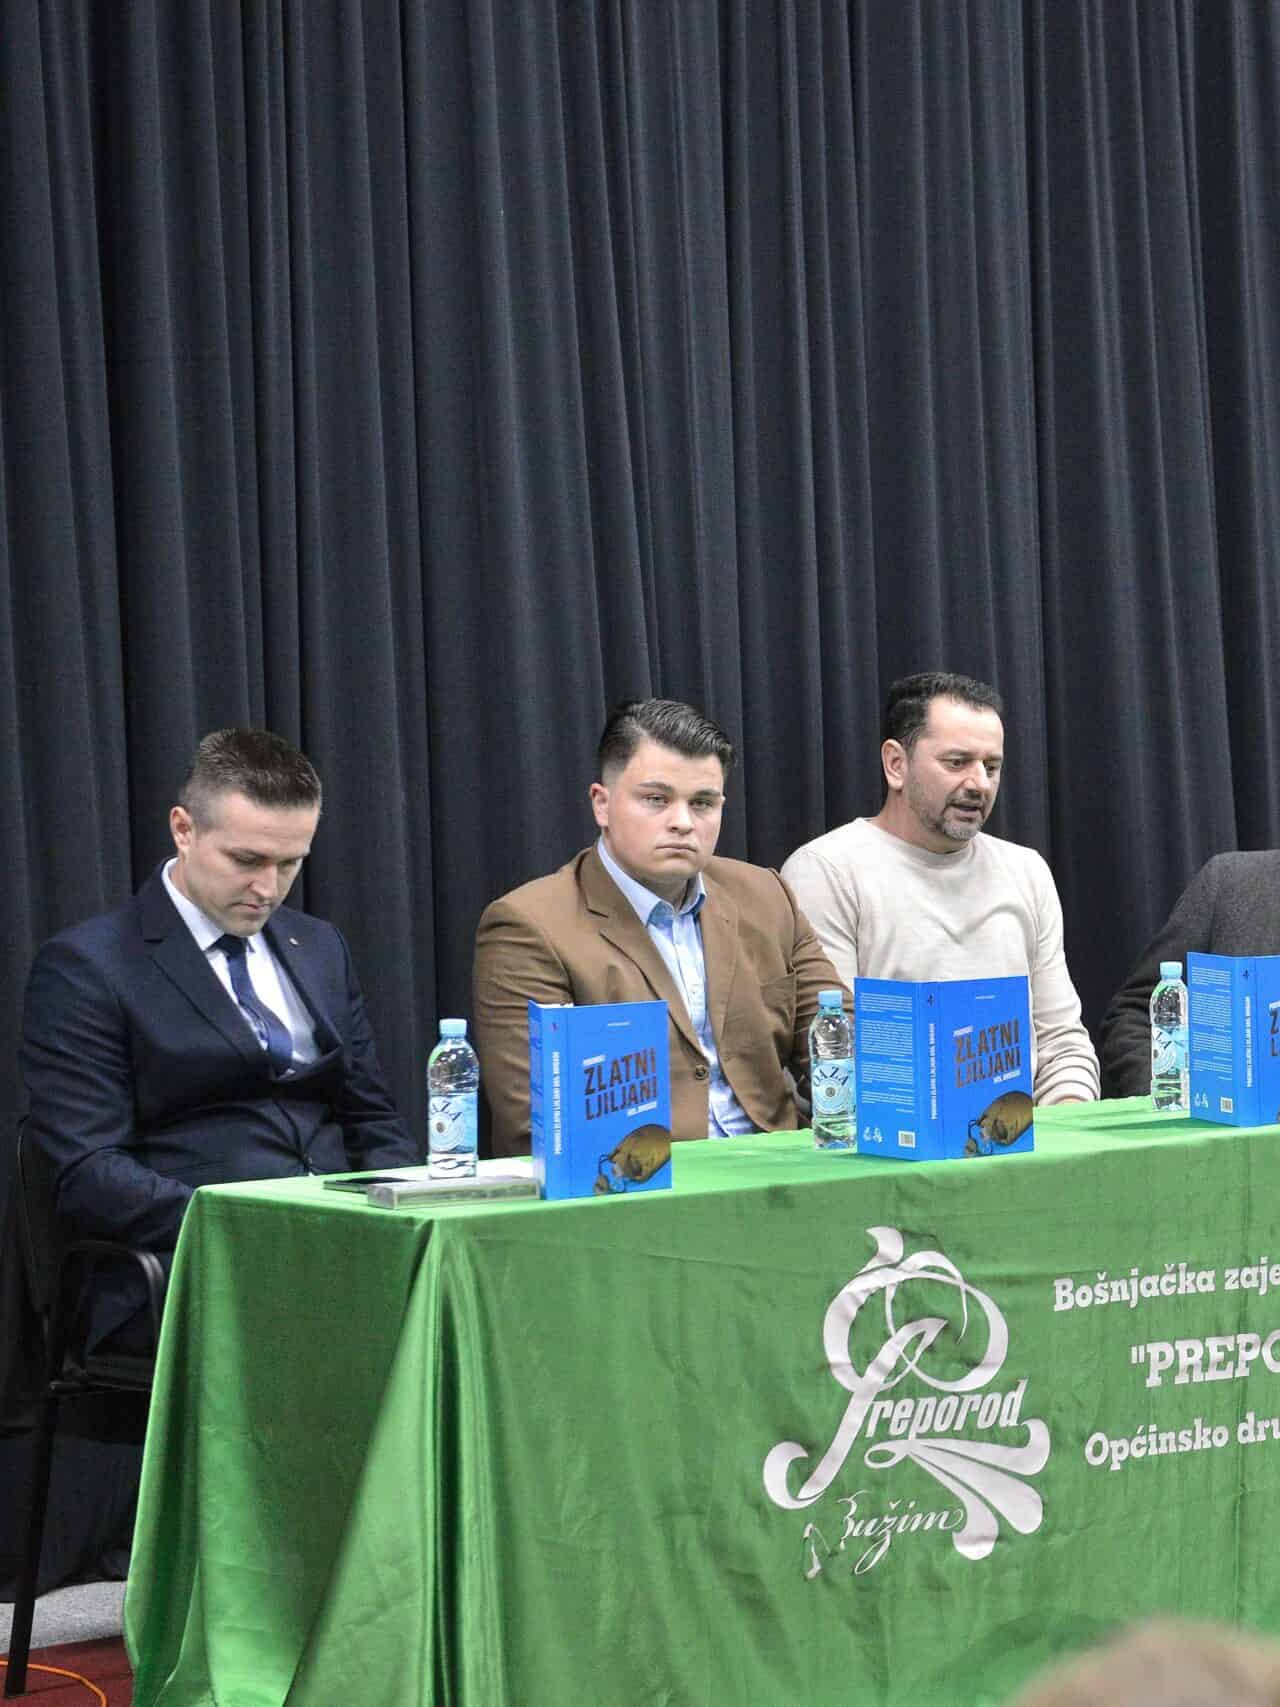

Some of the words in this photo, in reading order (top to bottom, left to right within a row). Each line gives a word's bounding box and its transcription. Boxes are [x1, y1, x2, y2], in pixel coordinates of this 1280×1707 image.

[955, 1018, 1020, 1064] ZLATNI
[583, 1047, 657, 1096] ZLATNI
[956, 1047, 1021, 1089] LJILJANI
[586, 1076, 658, 1120] LJILJANI
[1053, 1263, 1215, 1311] Bošnjačka
[1085, 1418, 1229, 1470] Općinsko
